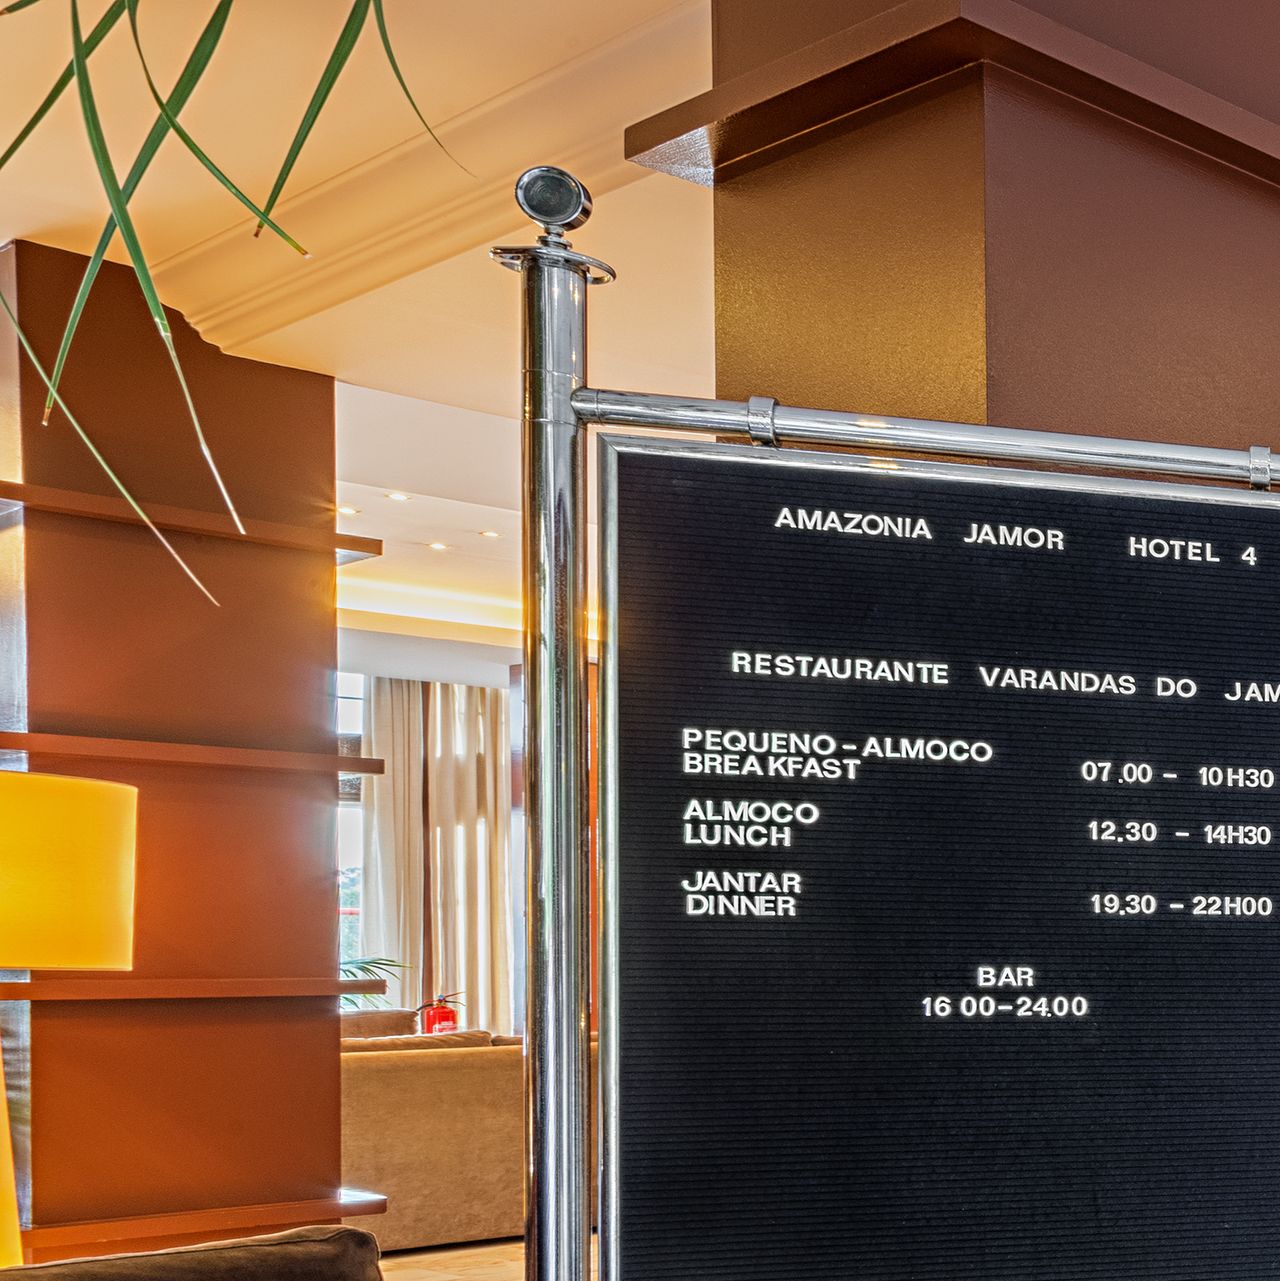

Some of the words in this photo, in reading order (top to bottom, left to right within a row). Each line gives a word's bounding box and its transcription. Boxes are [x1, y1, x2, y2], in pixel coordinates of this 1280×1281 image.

[774, 507, 933, 540] AMAZONIA
[963, 523, 1065, 551] JAMOR
[1129, 536, 1221, 563] HOTEL
[1241, 546, 1258, 566] 4
[731, 650, 949, 685] RESTAURANTE
[978, 666, 1137, 696] VARANDAS
[1156, 676, 1198, 699] DO
[682, 752, 862, 780] BREAKFAST
[1198, 766, 1275, 789] 10H30
[682, 798, 820, 825] ALMOCO
[683, 822, 792, 847] LUNCH
[1087, 820, 1158, 843] 12.30
[1203, 824, 1272, 846] 14H30
[680, 870, 802, 894] JANTAR
[685, 893, 797, 917] DINNER
[1090, 893, 1158, 916] 19.30
[976, 965, 1035, 988] BAR
